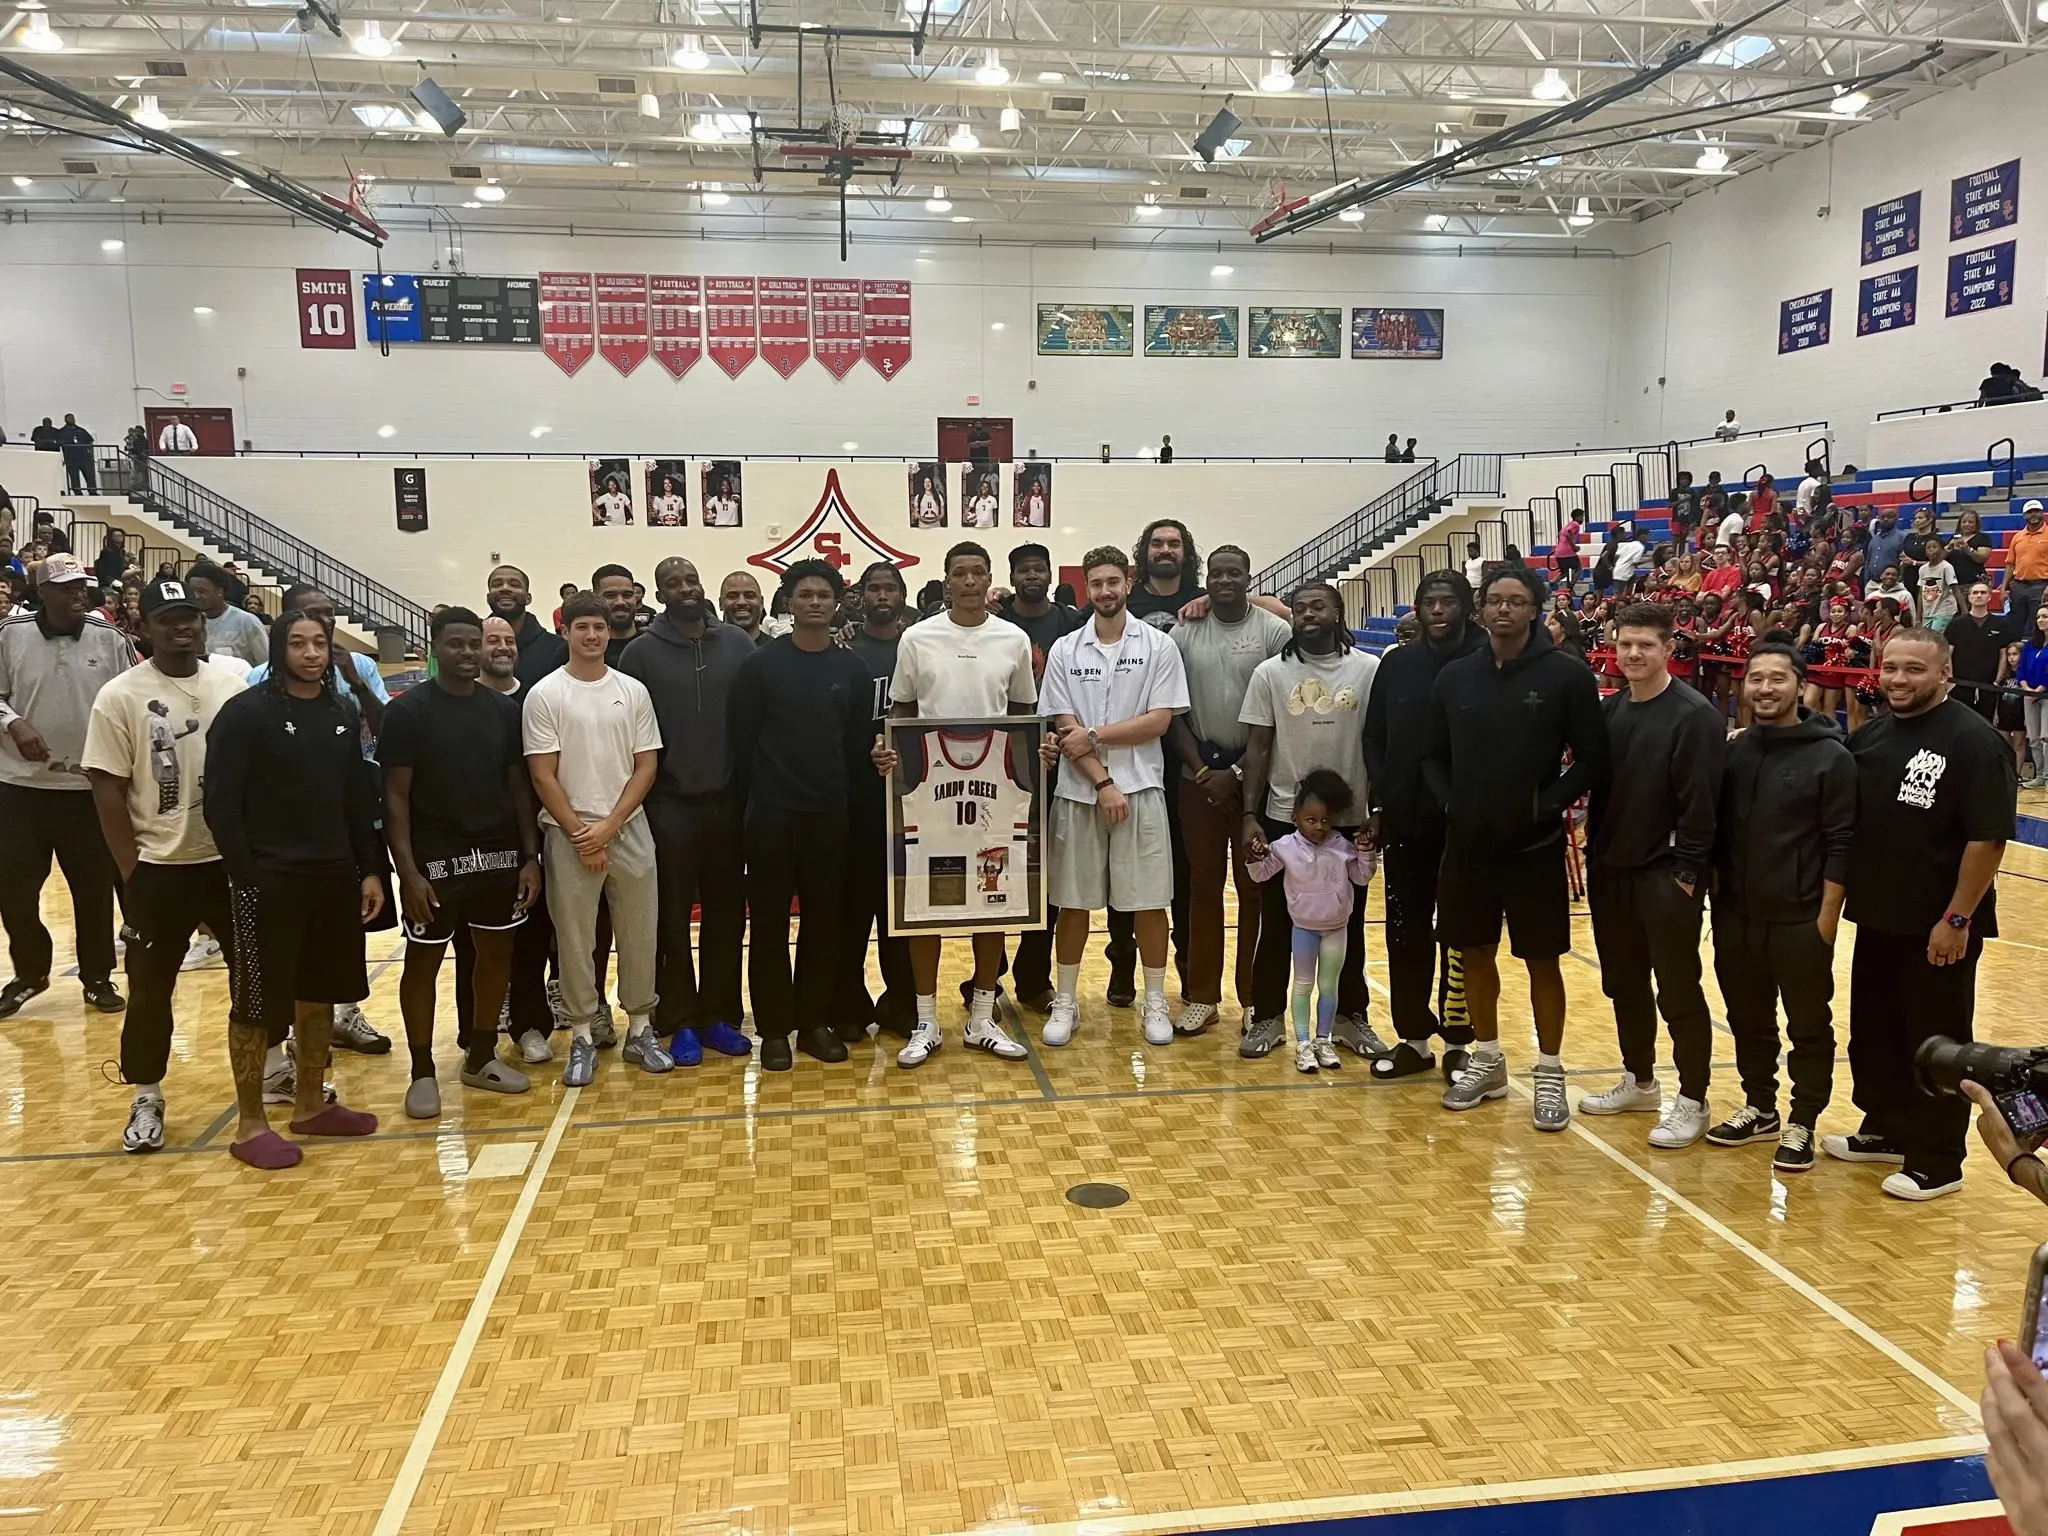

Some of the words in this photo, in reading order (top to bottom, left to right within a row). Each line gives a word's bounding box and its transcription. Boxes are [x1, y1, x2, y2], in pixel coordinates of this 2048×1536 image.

[1969, 168, 2000, 188] FOOTBALL
[1965, 189, 1983, 204] STATE
[1877, 199, 1905, 216] FOOTBALL
[1967, 200, 2000, 219] CHAMPIONS
[1875, 218, 1891, 231] STATE
[1975, 218, 1990, 232] 2012
[1875, 228, 1904, 245] CHAMPIONS
[1966, 249, 1996, 265] FOOTBALL
[1964, 268, 1981, 281] STATE
[1985, 264, 1996, 276] AAA
[302, 282, 347, 295] SMITH
[423, 279, 450, 287] GUEST
[507, 281, 532, 289] HOME
[660, 280, 690, 288] FOOTBALL
[769, 281, 782, 289] GIRLS
[783, 281, 798, 289] TRACK
[822, 282, 850, 290] VOLLEYBALL
[1875, 273, 1901, 289] FOOTBALL
[1963, 280, 1995, 297] CHAMPIONS
[1872, 290, 1888, 303] STATE
[1970, 297, 1986, 310] 2022
[1872, 302, 1901, 317] CHAMPIONS
[308, 303, 346, 336] 10
[1880, 318, 1892, 329] 2010
[1792, 322, 1817, 336] CHAMPIONS
[883, 358, 893, 373] SC
[405, 474, 414, 484] G
[1070, 668, 1082, 676] LES
[1084, 668, 1102, 676] BEN
[934, 780, 964, 801] SANDY
[968, 780, 997, 800] CREEK
[955, 801, 977, 825] 10
[426, 861, 448, 880] BE
